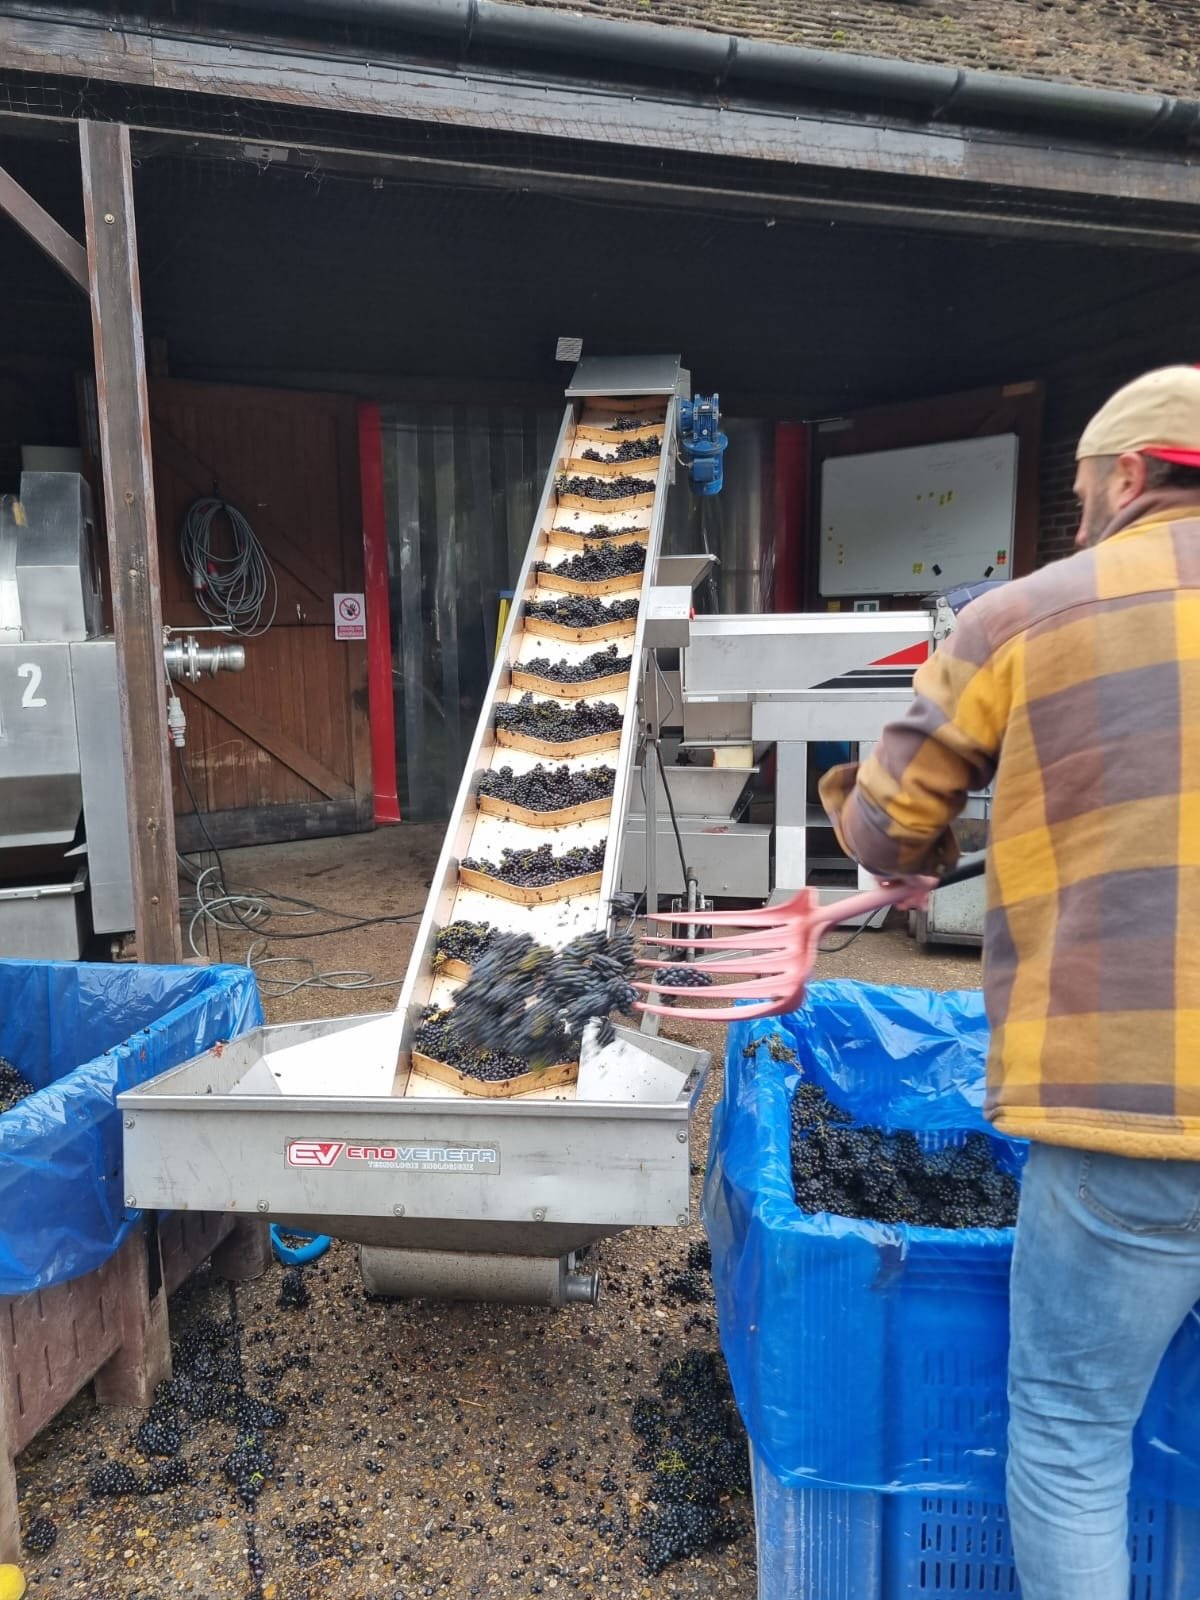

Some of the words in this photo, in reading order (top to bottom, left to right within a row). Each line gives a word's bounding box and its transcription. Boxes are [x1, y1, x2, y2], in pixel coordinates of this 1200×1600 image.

[17, 662, 47, 708] 2
[288, 1142, 342, 1166] EV
[346, 1147, 496, 1162] ENOVENETA
